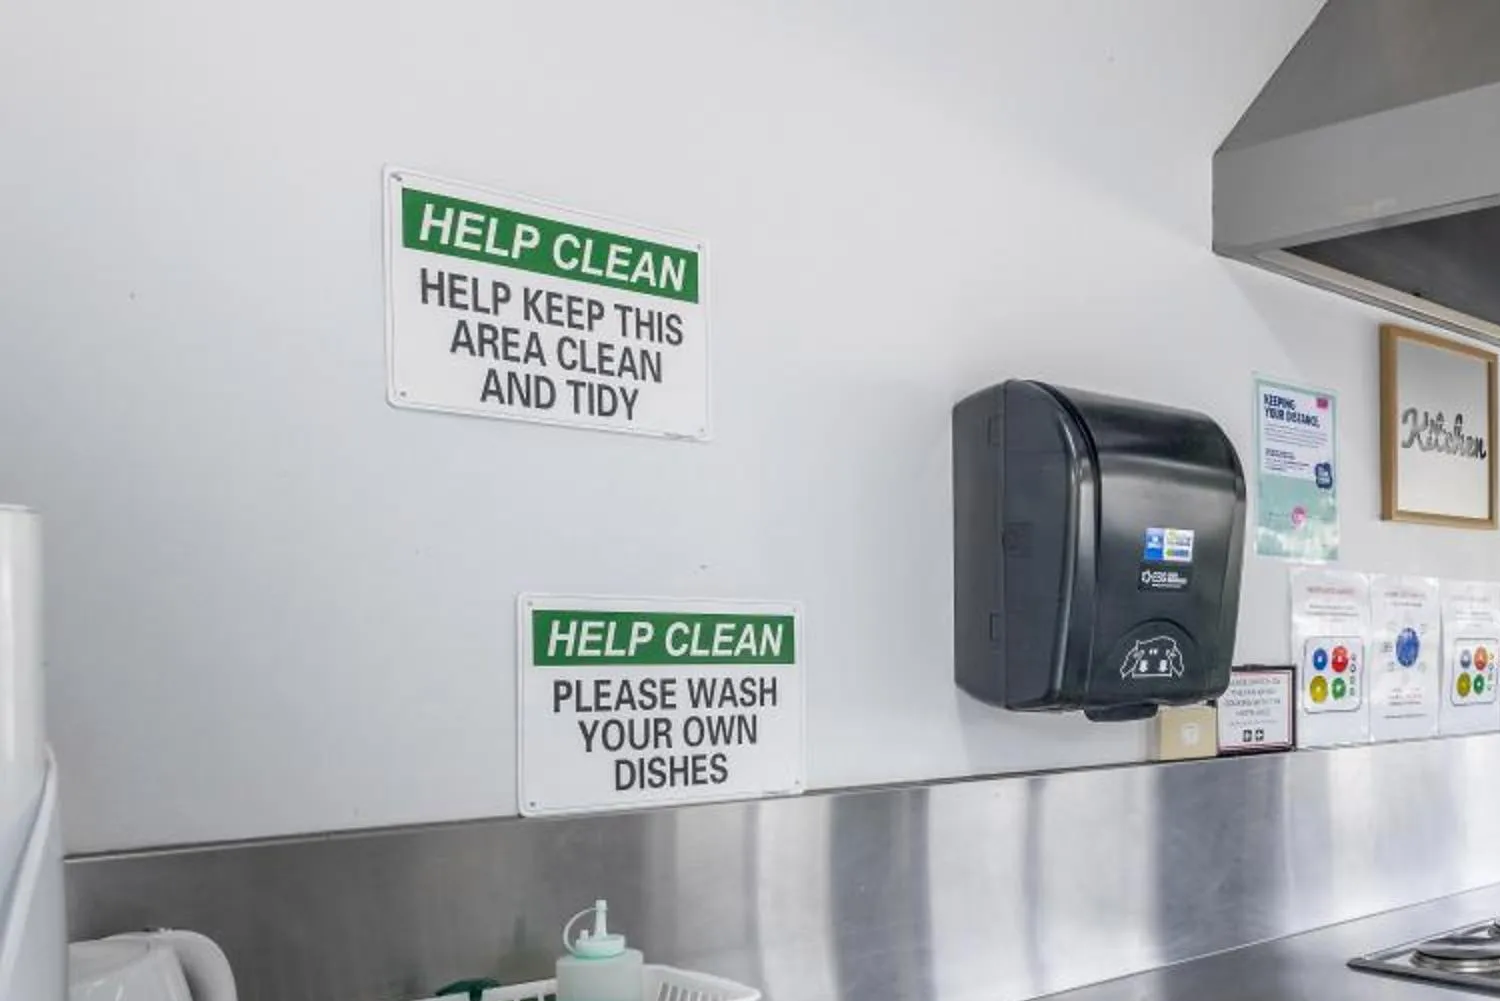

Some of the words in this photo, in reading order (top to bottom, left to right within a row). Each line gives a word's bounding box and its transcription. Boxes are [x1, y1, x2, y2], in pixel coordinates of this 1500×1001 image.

[419, 203, 541, 260] HELP
[552, 233, 687, 292] CLEAN
[420, 267, 512, 316] HELP
[523, 287, 606, 333] KEEP
[613, 303, 684, 347] THIS
[449, 319, 547, 367] AREA
[556, 335, 663, 384] CLEAN
[479, 368, 557, 411] AND
[565, 379, 639, 421] TIDY
[1264, 407, 1285, 421] YOUR
[1401, 407, 1487, 461] Kitchen
[547, 619, 655, 657] HELP
[664, 621, 784, 657] CLEAN
[553, 677, 678, 714] PLEASE
[686, 676, 778, 709] WASH
[577, 717, 674, 753] YOUR
[682, 713, 758, 748] OWN
[614, 752, 729, 792] DISHES
